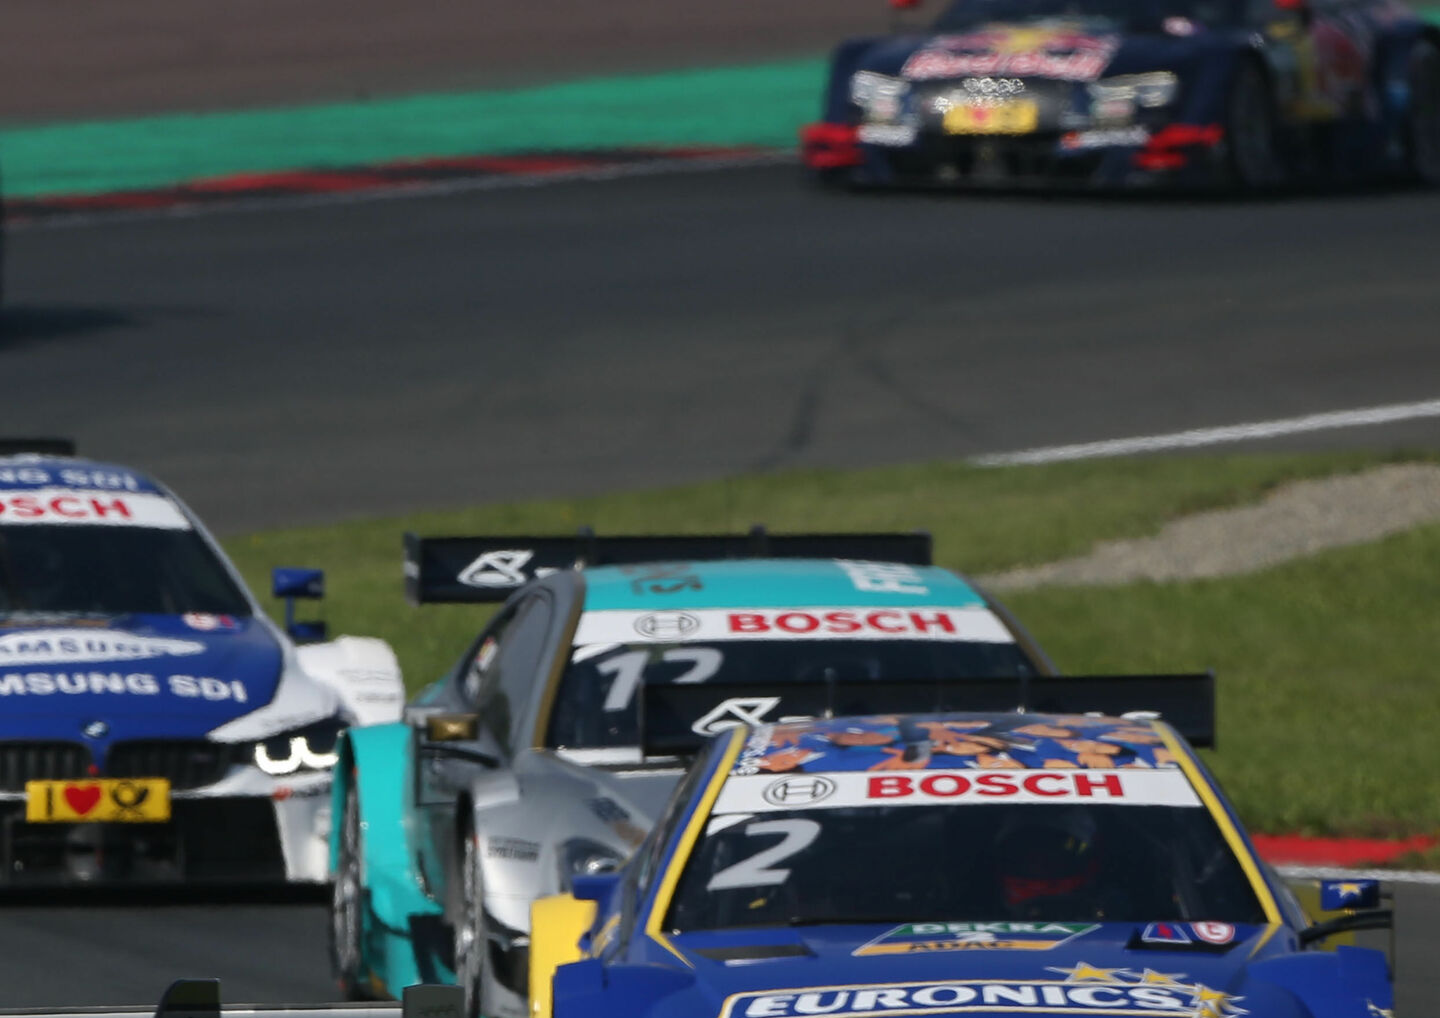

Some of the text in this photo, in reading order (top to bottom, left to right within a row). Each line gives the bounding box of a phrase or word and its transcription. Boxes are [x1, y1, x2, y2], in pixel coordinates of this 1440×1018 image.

[727, 612, 957, 637] BOSCH
[168, 674, 248, 703] SDI
[866, 774, 1125, 800] BOSCH
[707, 818, 822, 891] 2
[744, 981, 1184, 1018] EURONICS
